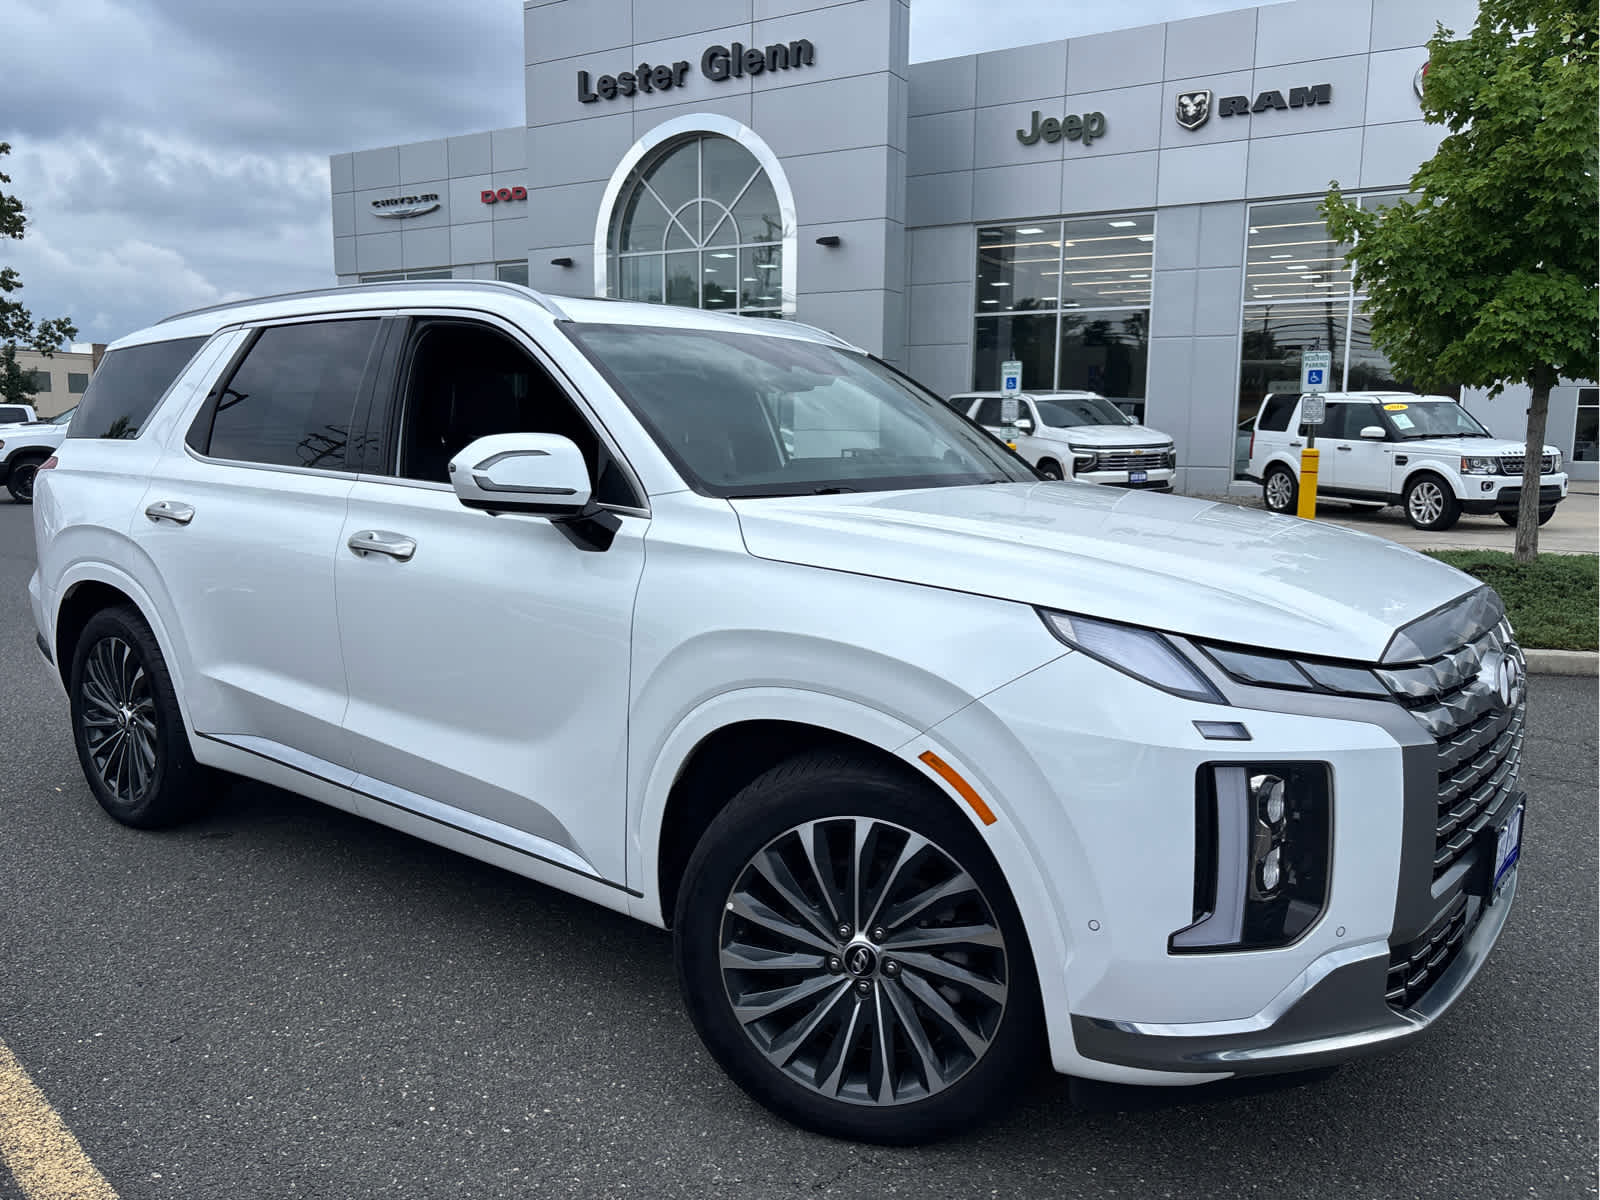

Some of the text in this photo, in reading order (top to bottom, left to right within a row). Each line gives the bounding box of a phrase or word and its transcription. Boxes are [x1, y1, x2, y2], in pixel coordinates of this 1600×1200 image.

[577, 38, 815, 104] Lester Glenn
[1219, 83, 1332, 117] RAM
[1016, 110, 1106, 145] Jeep
[371, 193, 439, 208] CHRYSLER
